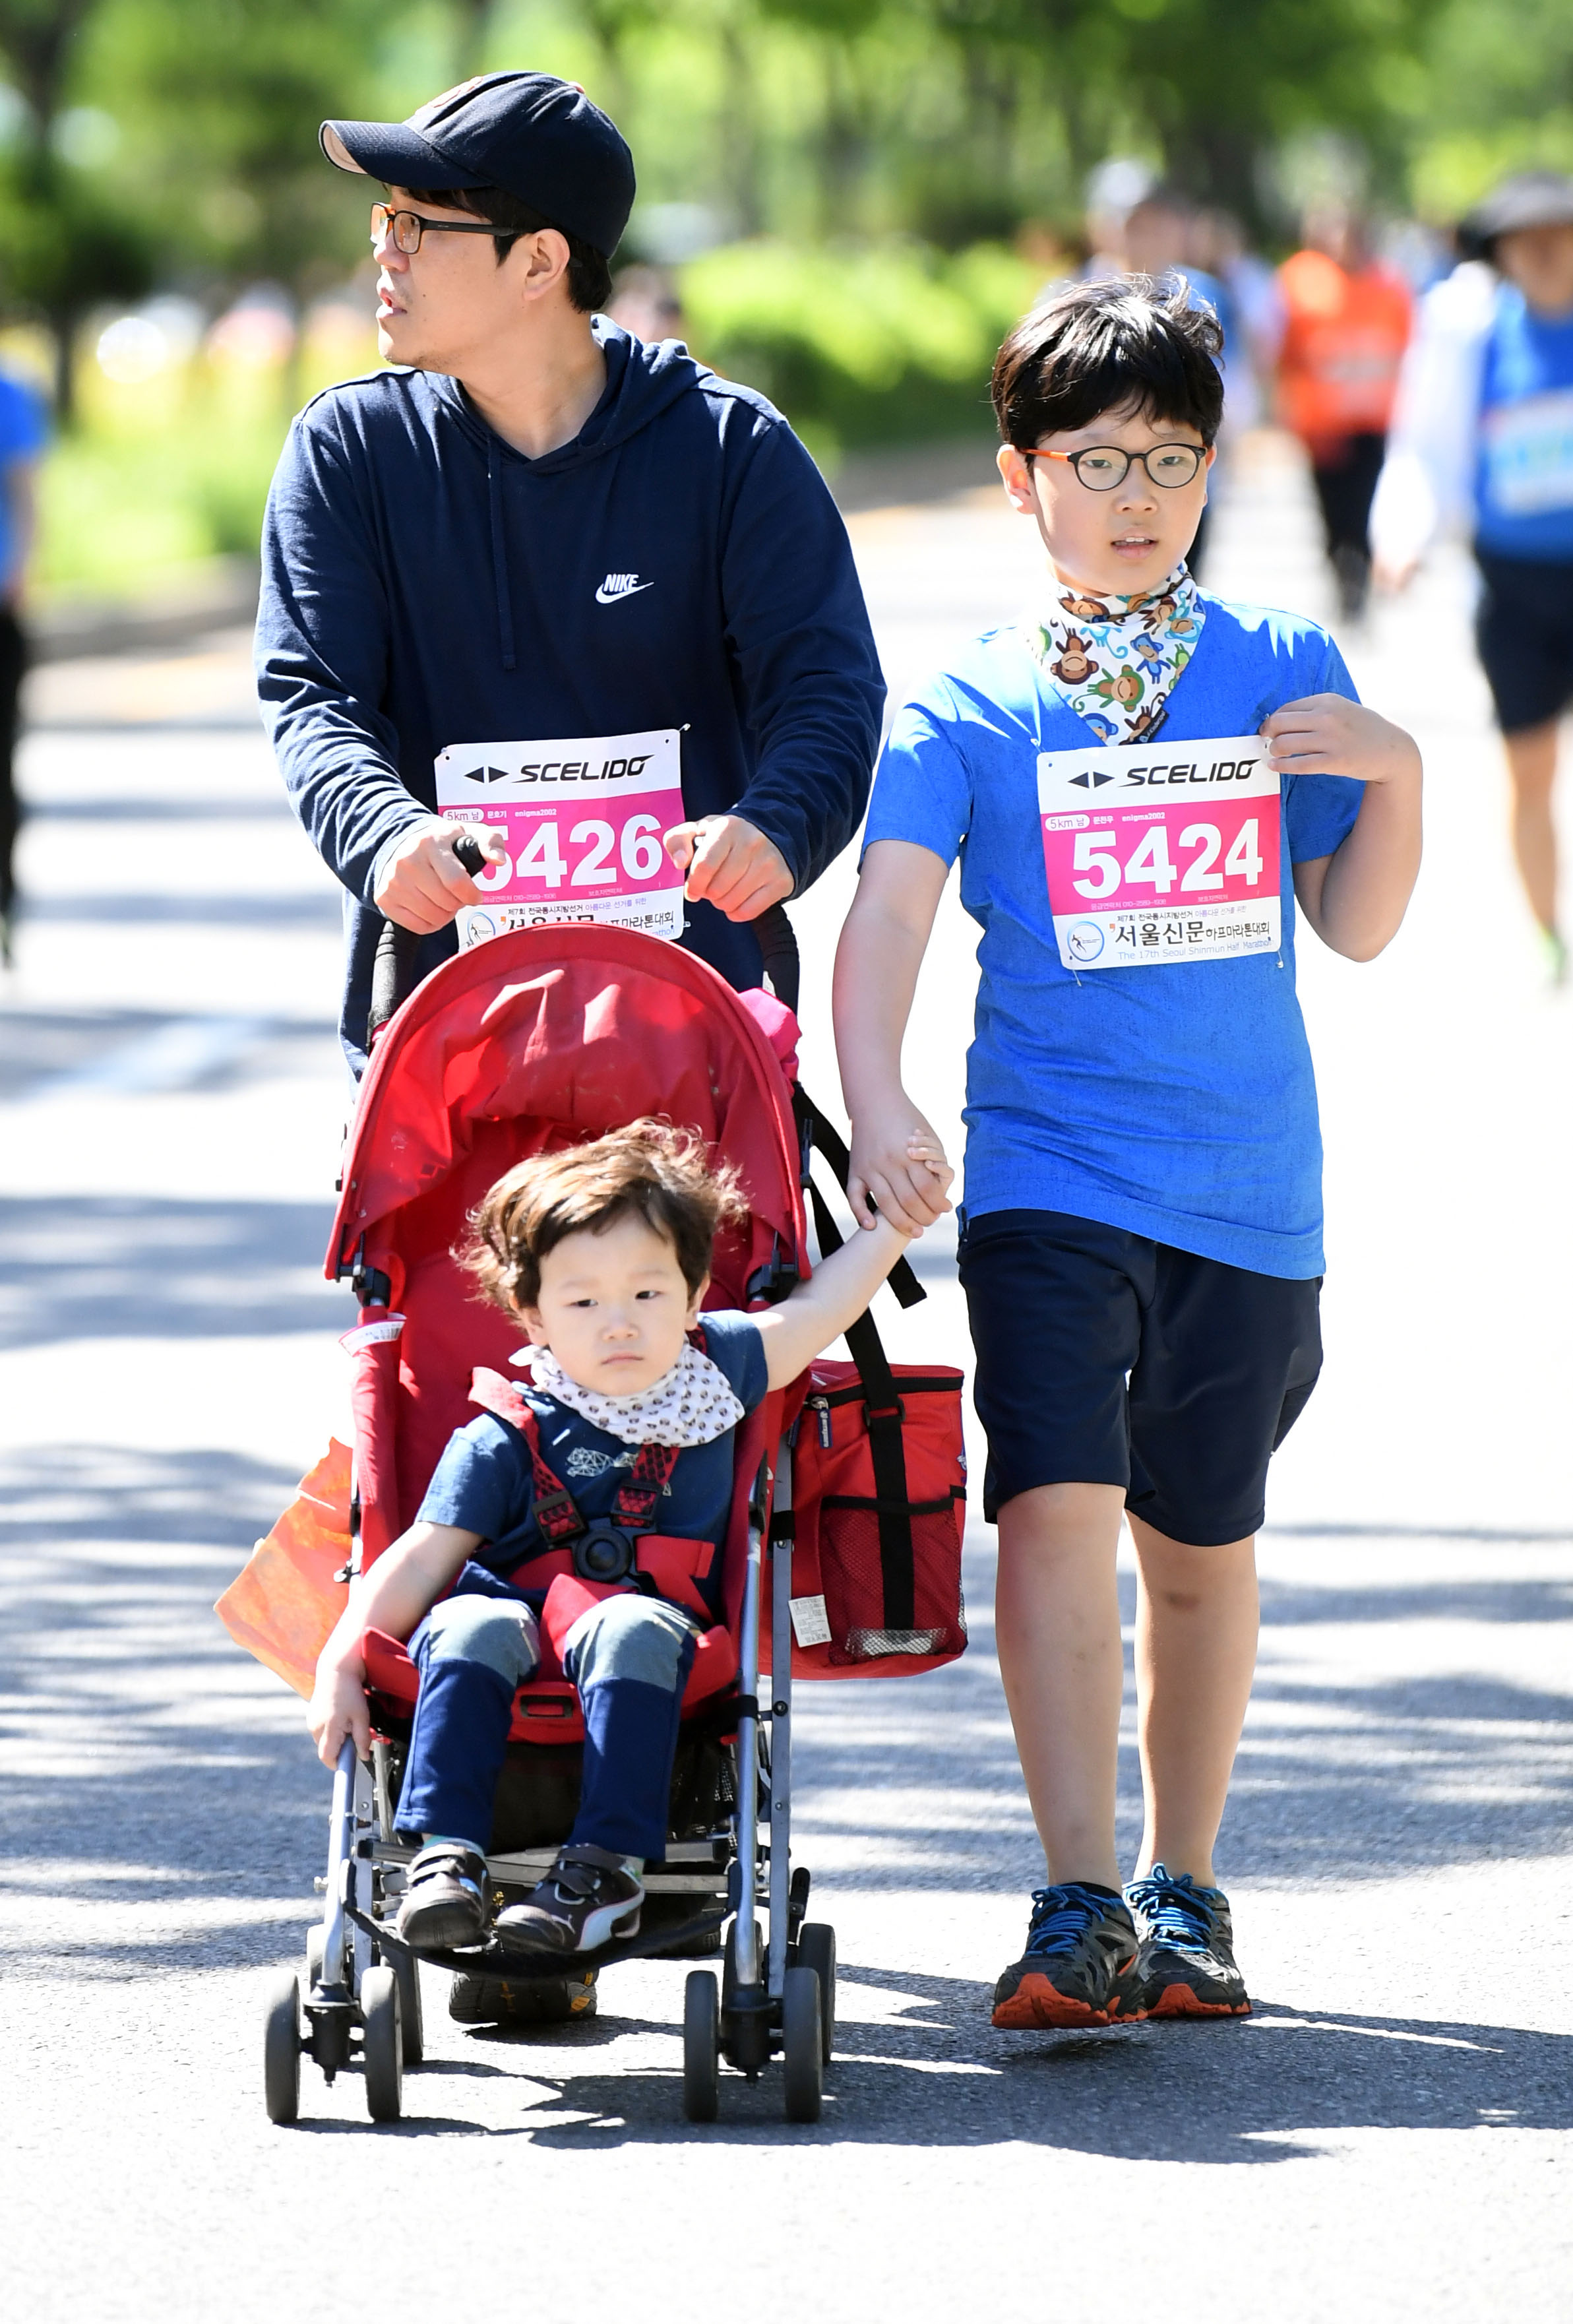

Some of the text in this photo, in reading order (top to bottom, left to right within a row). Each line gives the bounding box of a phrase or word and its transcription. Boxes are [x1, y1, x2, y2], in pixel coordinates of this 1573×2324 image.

[603, 573, 639, 592] NIKE
[512, 755, 656, 783] SCELIDO
[1117, 759, 1262, 788] SCELIDO
[447, 811, 469, 821] 5km
[472, 812, 479, 821] 남
[514, 809, 557, 817] enigma2002
[1050, 819, 1072, 829] 5km
[1076, 818, 1084, 827] 남
[1122, 812, 1165, 822] enigma2002
[1072, 818, 1263, 899] 5424
[528, 904, 582, 915] 전국동시지방선거
[585, 902, 611, 910] 아름다운
[1138, 912, 1192, 922] 전국동시지방선거
[1115, 921, 1270, 947] 서울신문 하프마라톤대회
[1119, 951, 1135, 960] The
[1140, 950, 1159, 959] 17th
[1163, 949, 1186, 958] Seoul
[1189, 944, 1225, 955] Shinmun
[1227, 942, 1240, 951] Half
